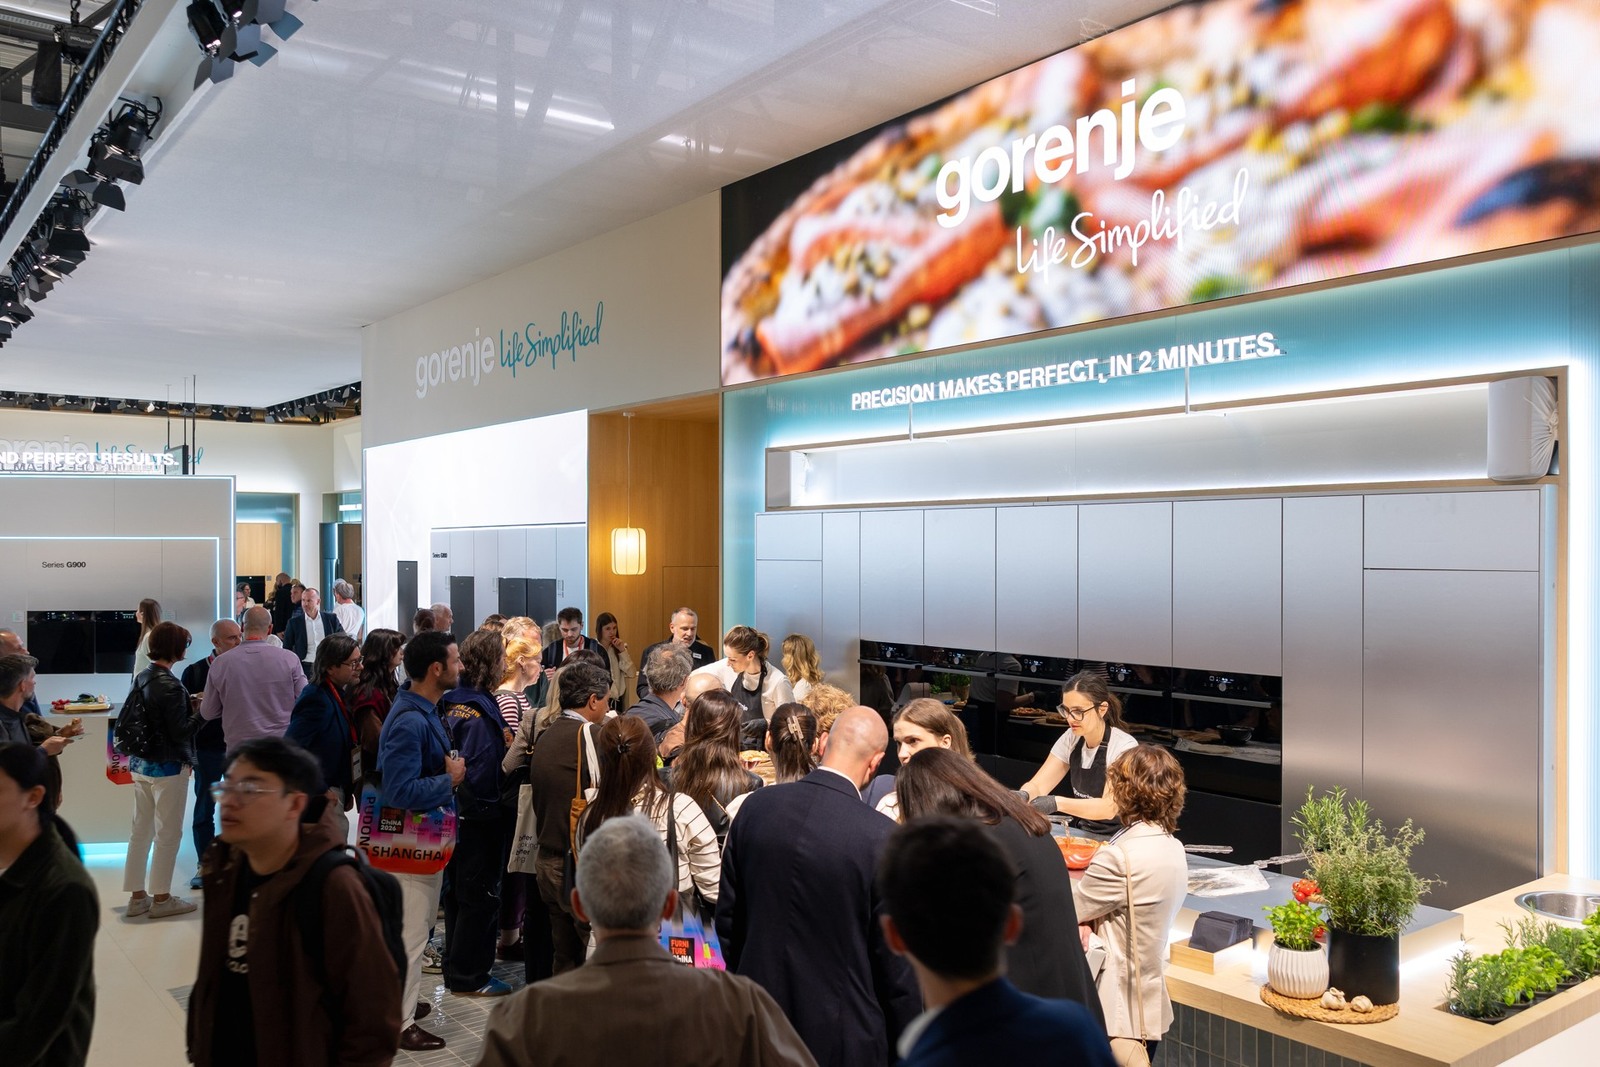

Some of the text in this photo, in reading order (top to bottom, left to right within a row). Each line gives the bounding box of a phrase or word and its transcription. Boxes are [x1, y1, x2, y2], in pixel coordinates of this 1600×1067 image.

[936, 78, 1187, 229] gorenje
[1071, 168, 1249, 268] Simplified
[415, 327, 495, 399] gorenje
[525, 301, 604, 370] Simplified
[851, 332, 1281, 410] PRECISION MAKES PERFECT, IN 2 MINUTES.
[22, 452, 98, 465] PERFECT
[101, 452, 179, 466] RESULTS.
[371, 845, 445, 861] SHANGHA
